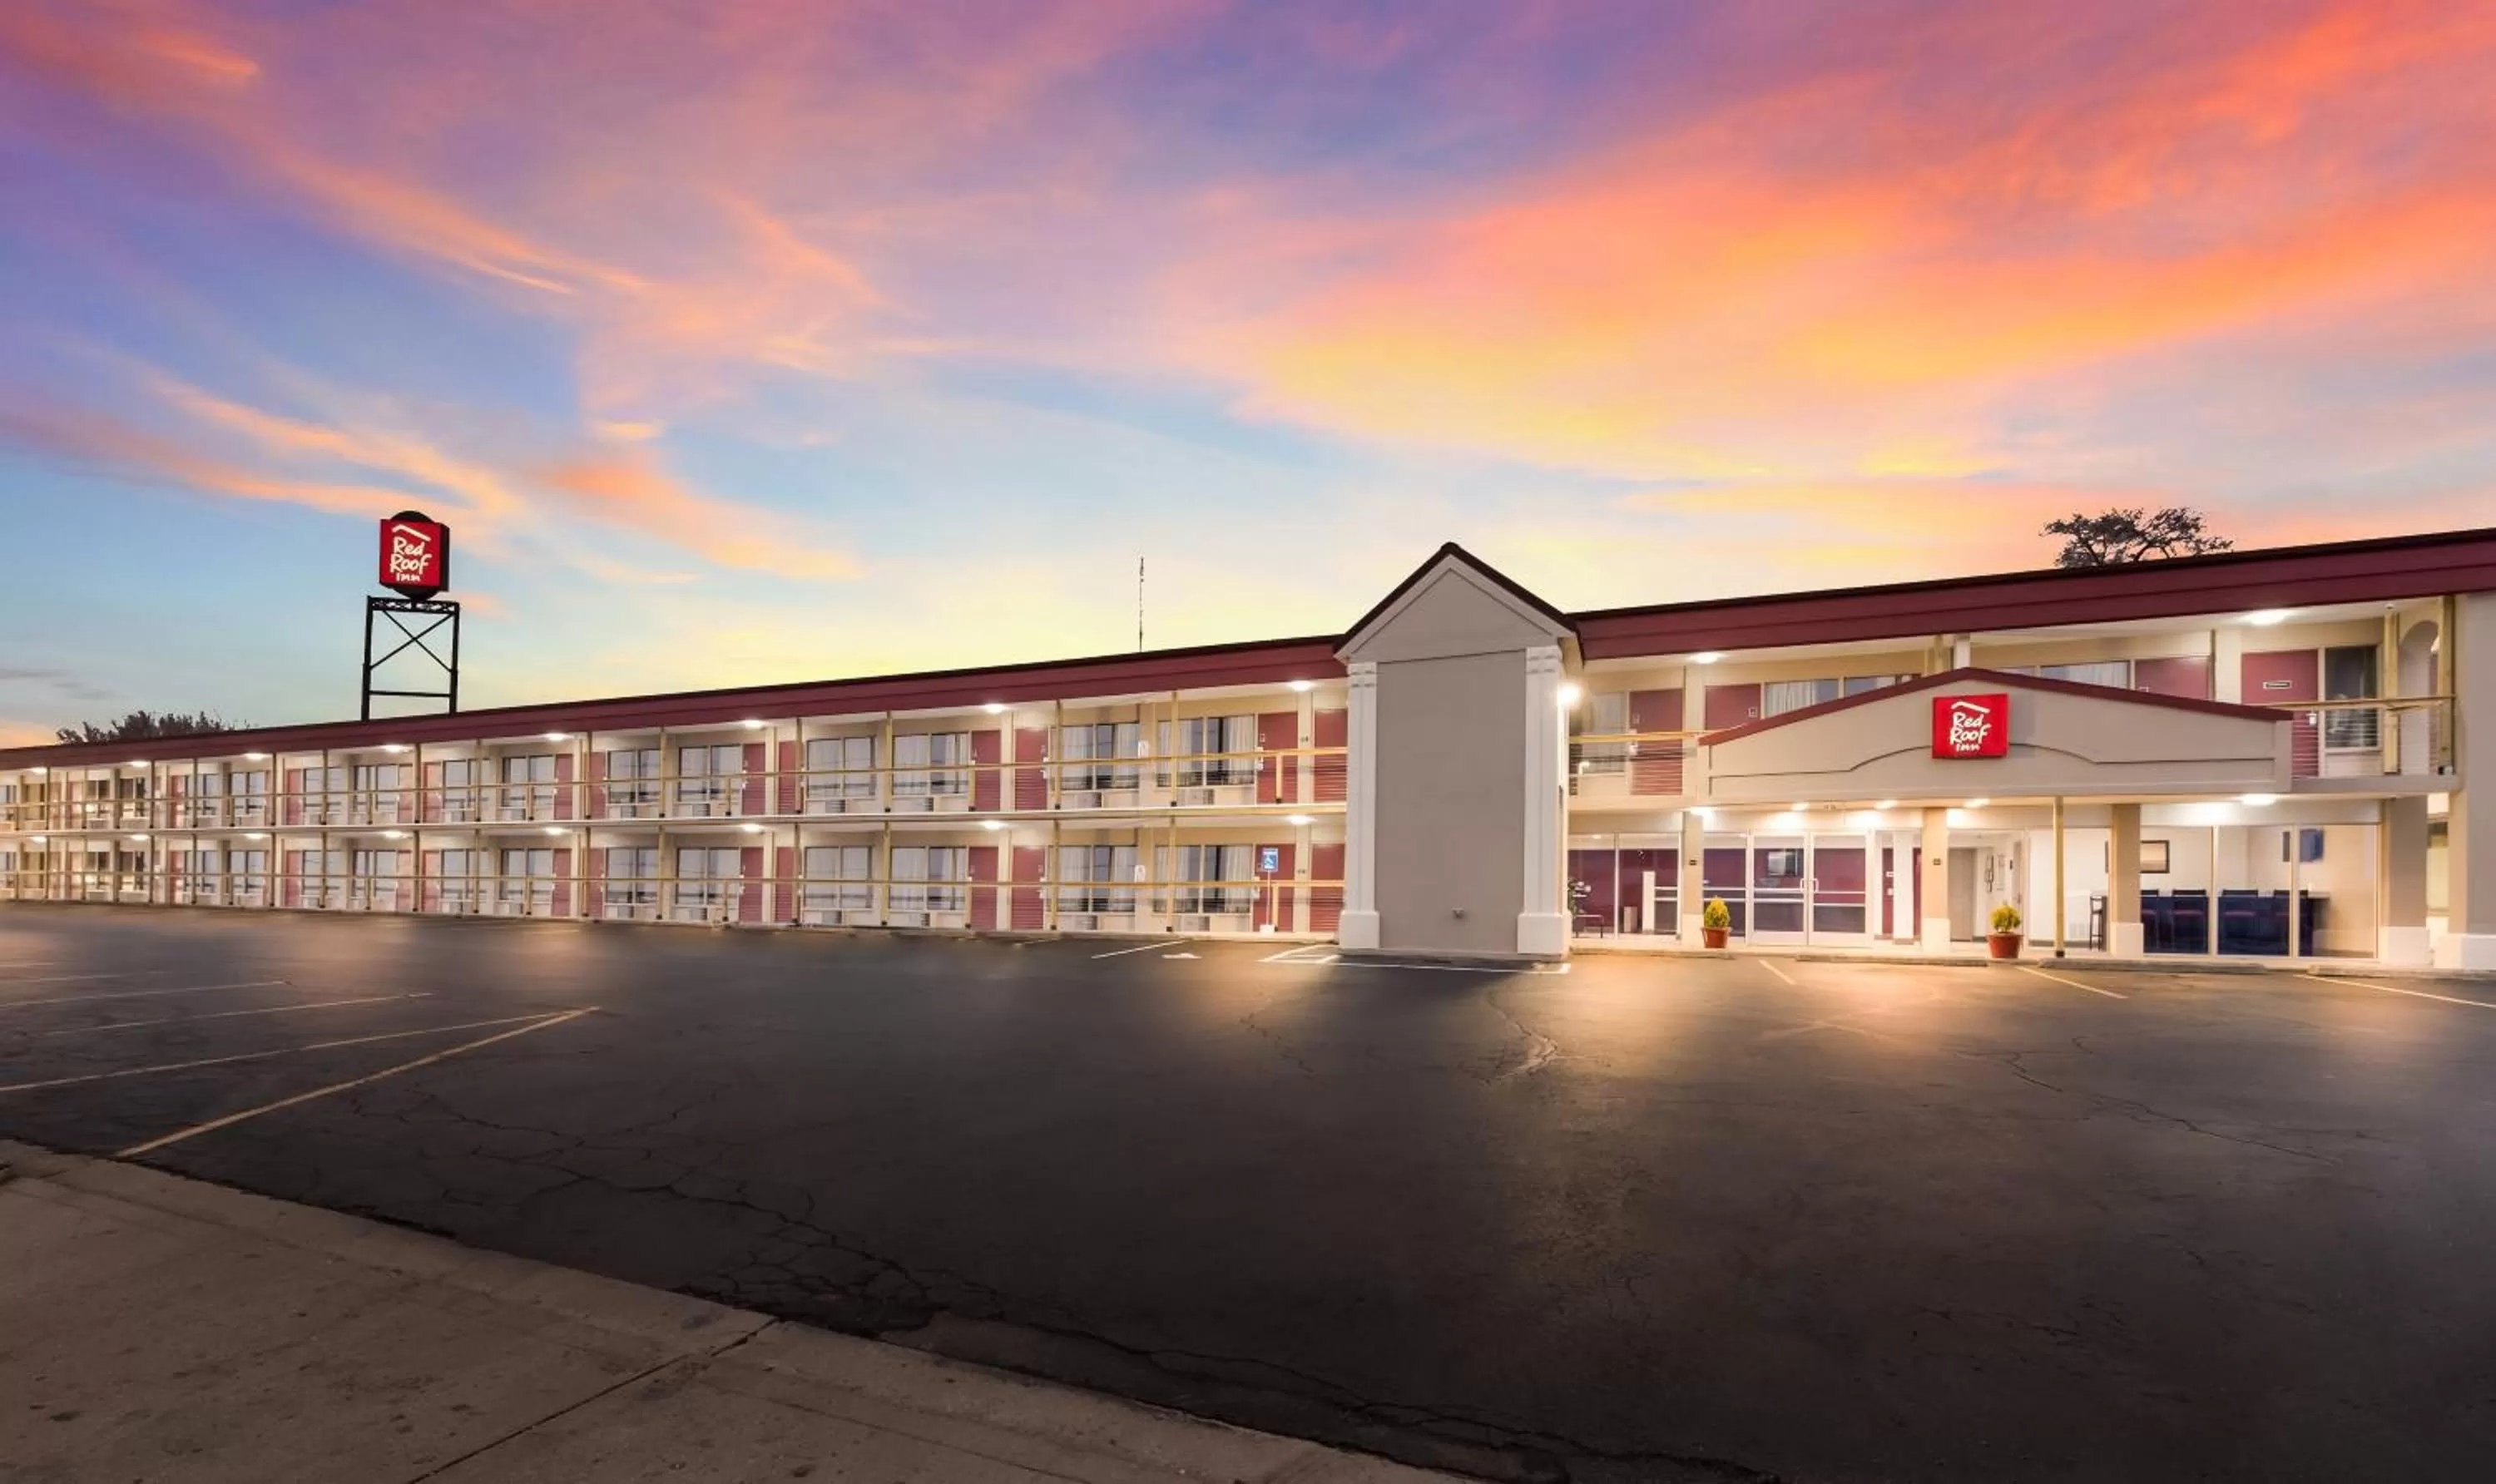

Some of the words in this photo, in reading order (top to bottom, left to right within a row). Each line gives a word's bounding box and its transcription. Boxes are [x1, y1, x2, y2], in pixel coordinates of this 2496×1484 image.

[394, 537, 424, 555] Red
[389, 553, 432, 574] Roof
[1954, 712, 1983, 729] Red
[1950, 724, 1992, 744] Roof
